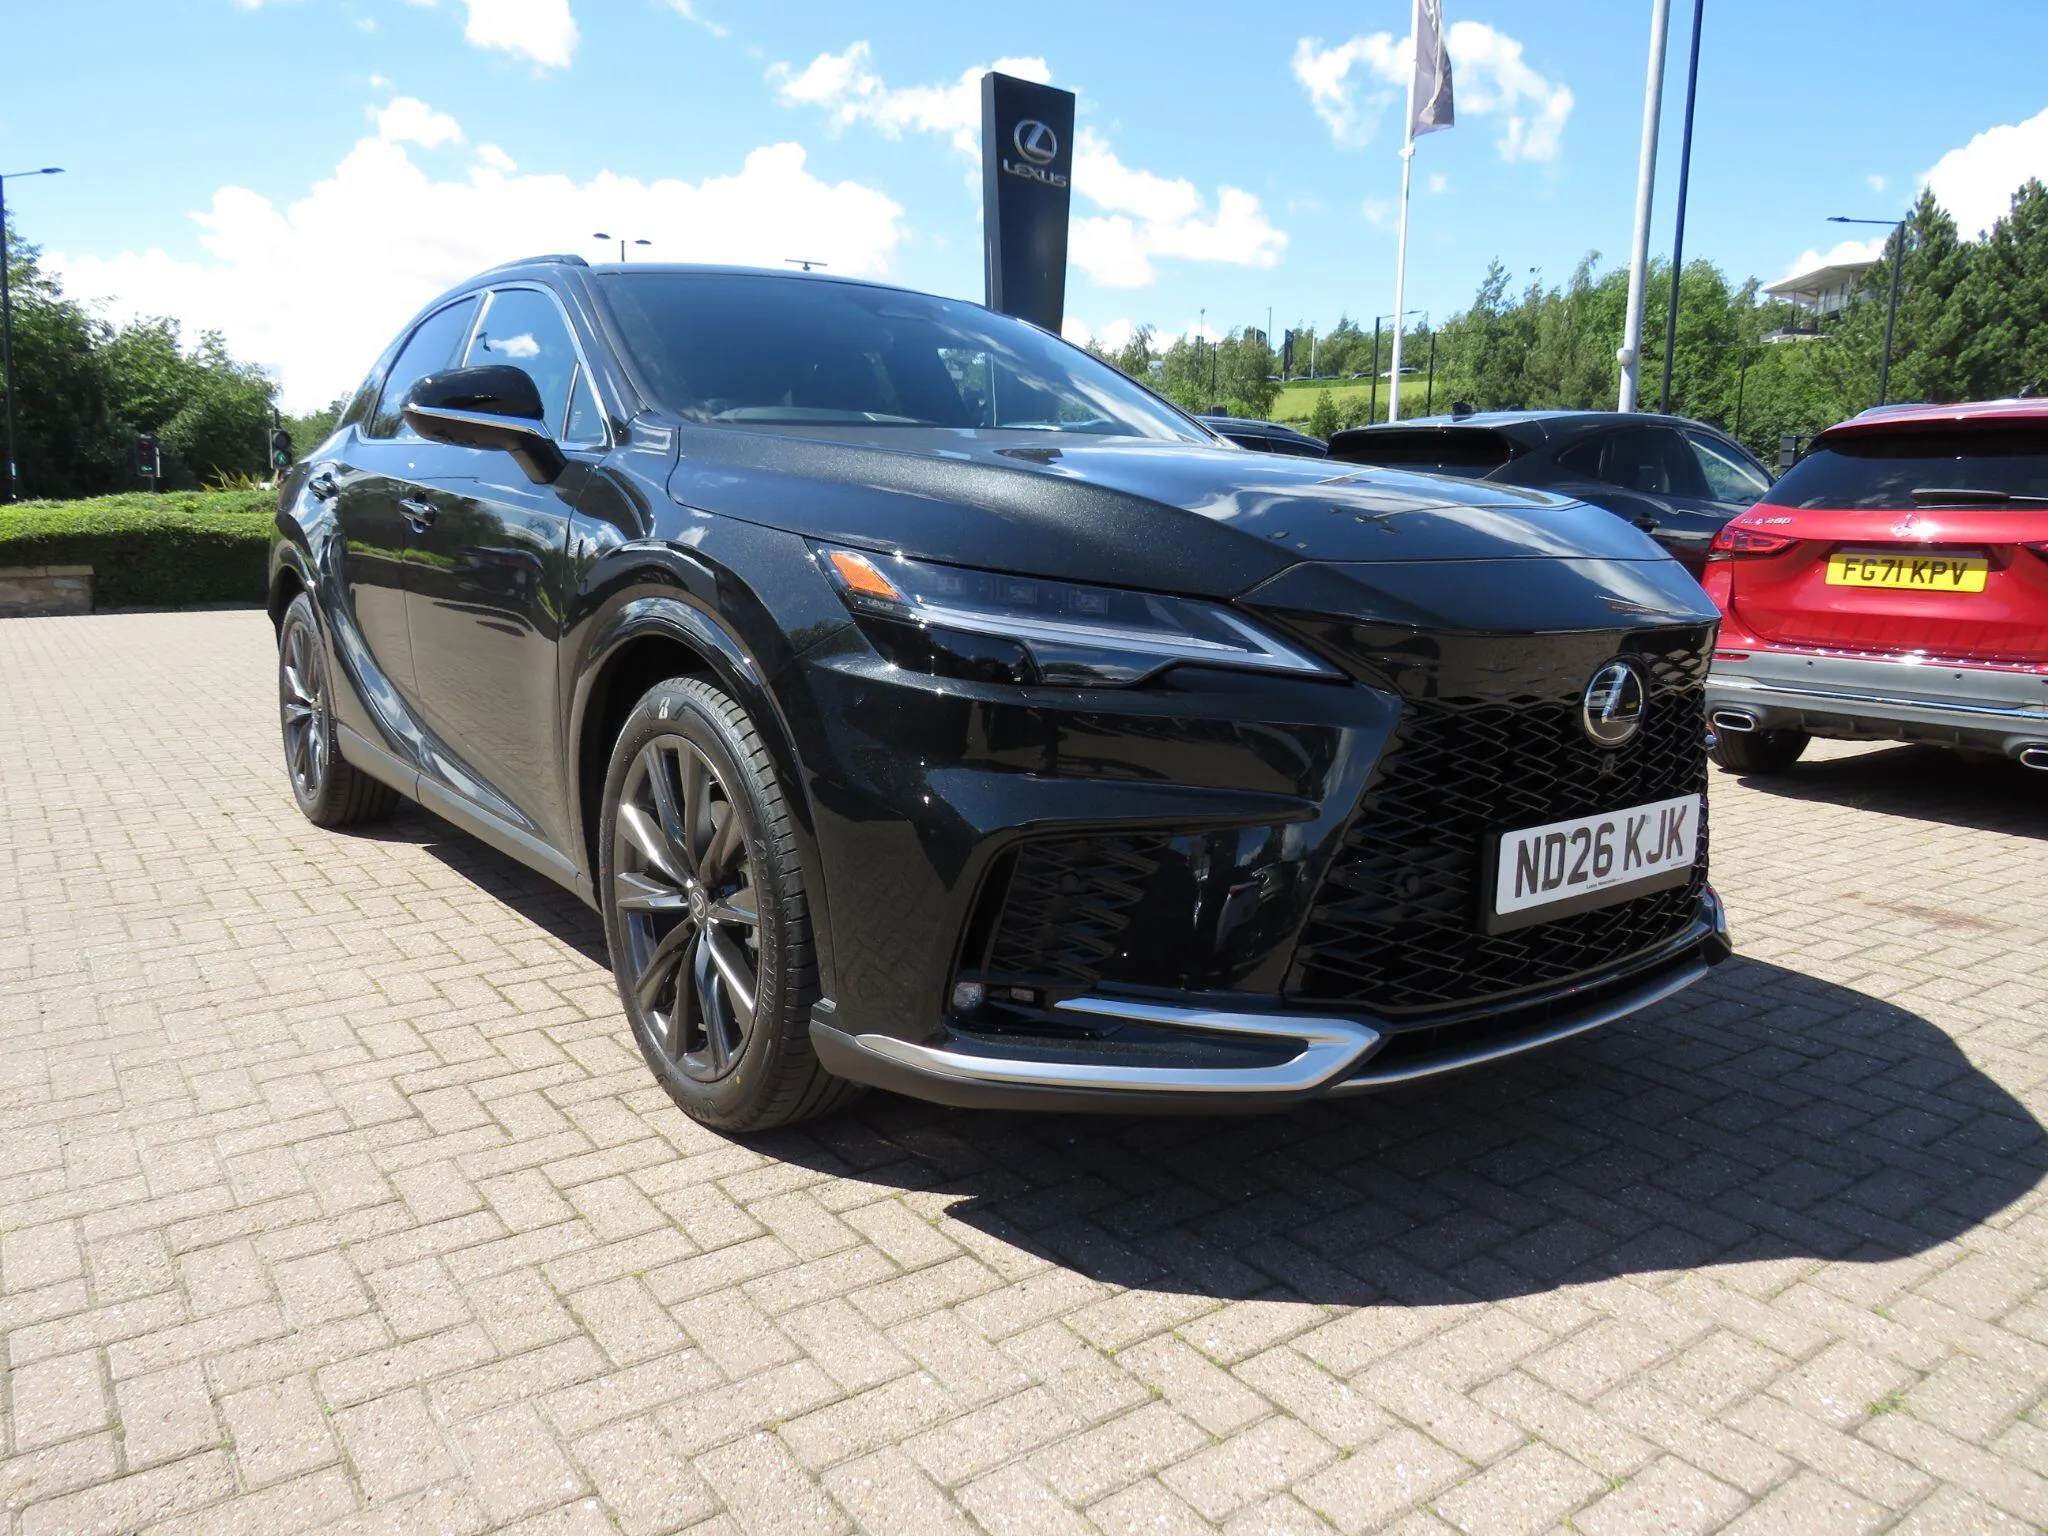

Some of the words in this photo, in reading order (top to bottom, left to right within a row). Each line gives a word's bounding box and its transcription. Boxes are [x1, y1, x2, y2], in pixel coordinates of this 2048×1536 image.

[1003, 158, 1067, 188] LEXUS
[1843, 558, 1903, 582] FG71
[1910, 559, 1968, 585] KPV
[1515, 822, 1615, 898] ND26
[1623, 805, 1687, 871] KJK
